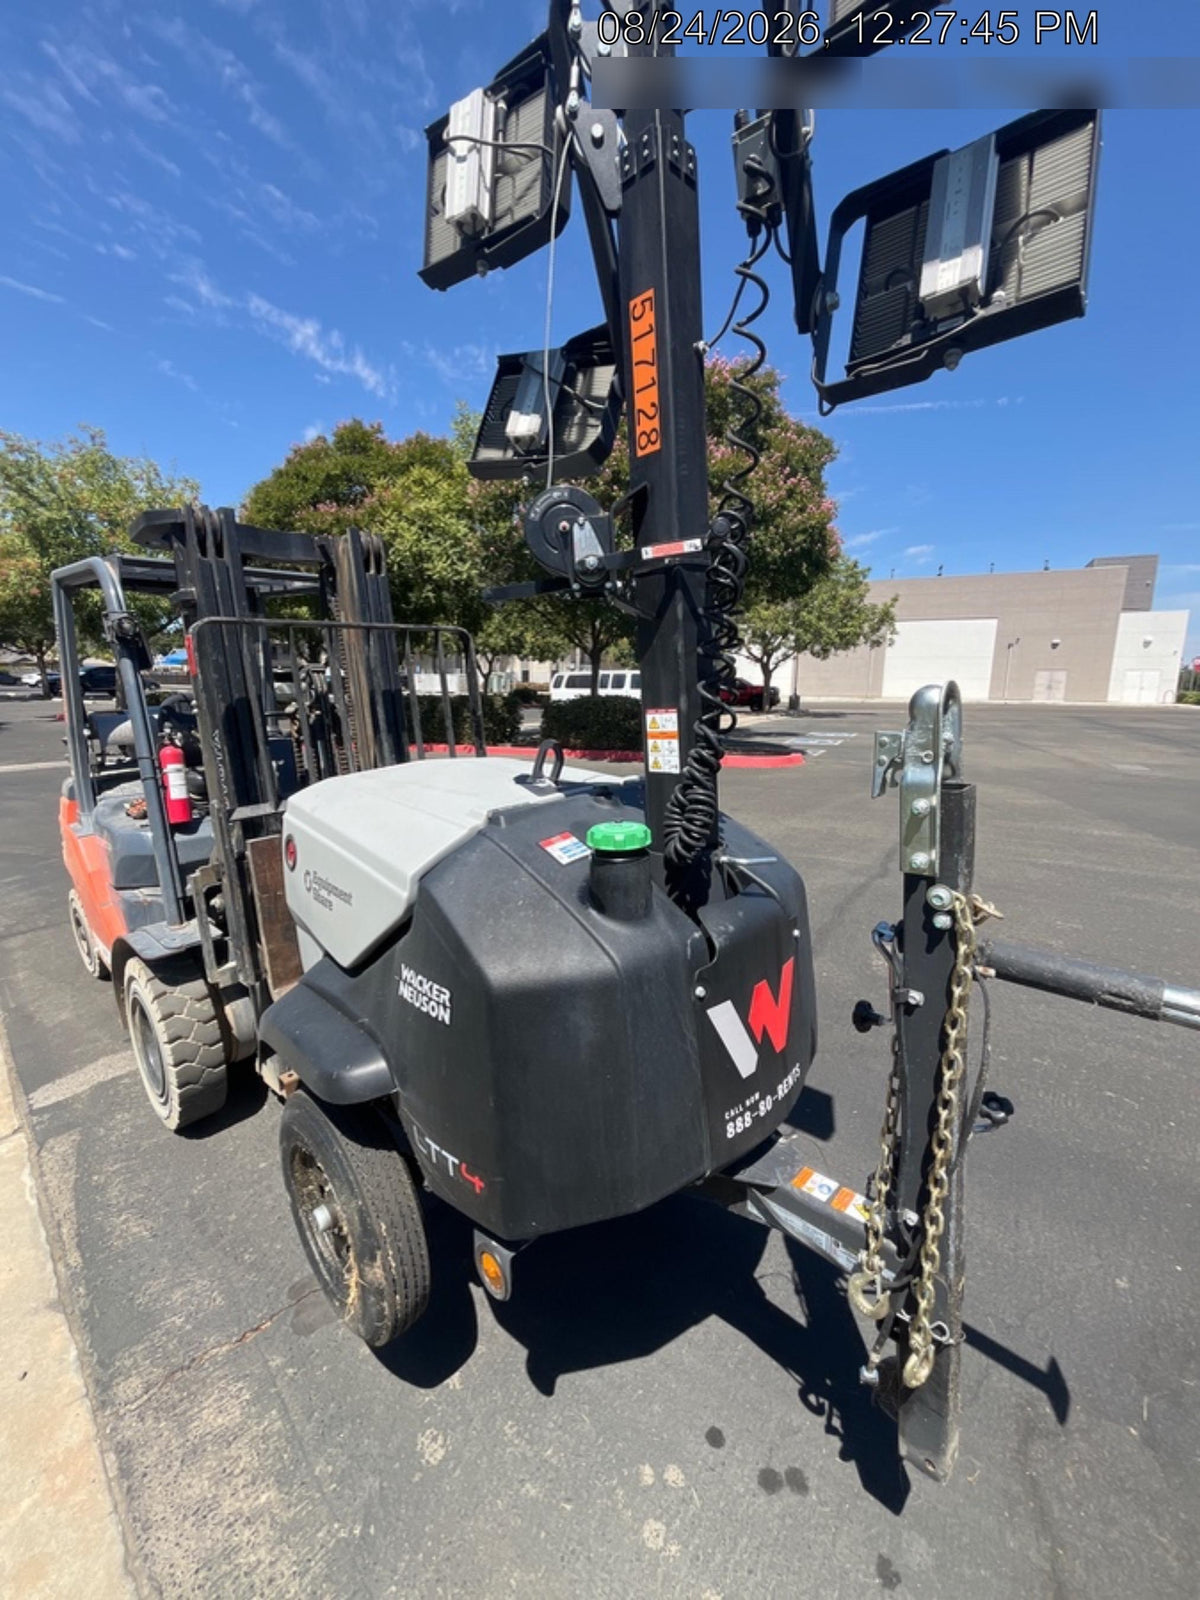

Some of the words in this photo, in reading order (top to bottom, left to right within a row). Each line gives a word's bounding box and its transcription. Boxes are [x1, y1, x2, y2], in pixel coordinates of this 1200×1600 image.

[631, 296, 660, 450] 517128
[398, 980, 451, 1025] NEUSON
[401, 963, 451, 1007] WACKER
[413, 1125, 485, 1194] LTT4
